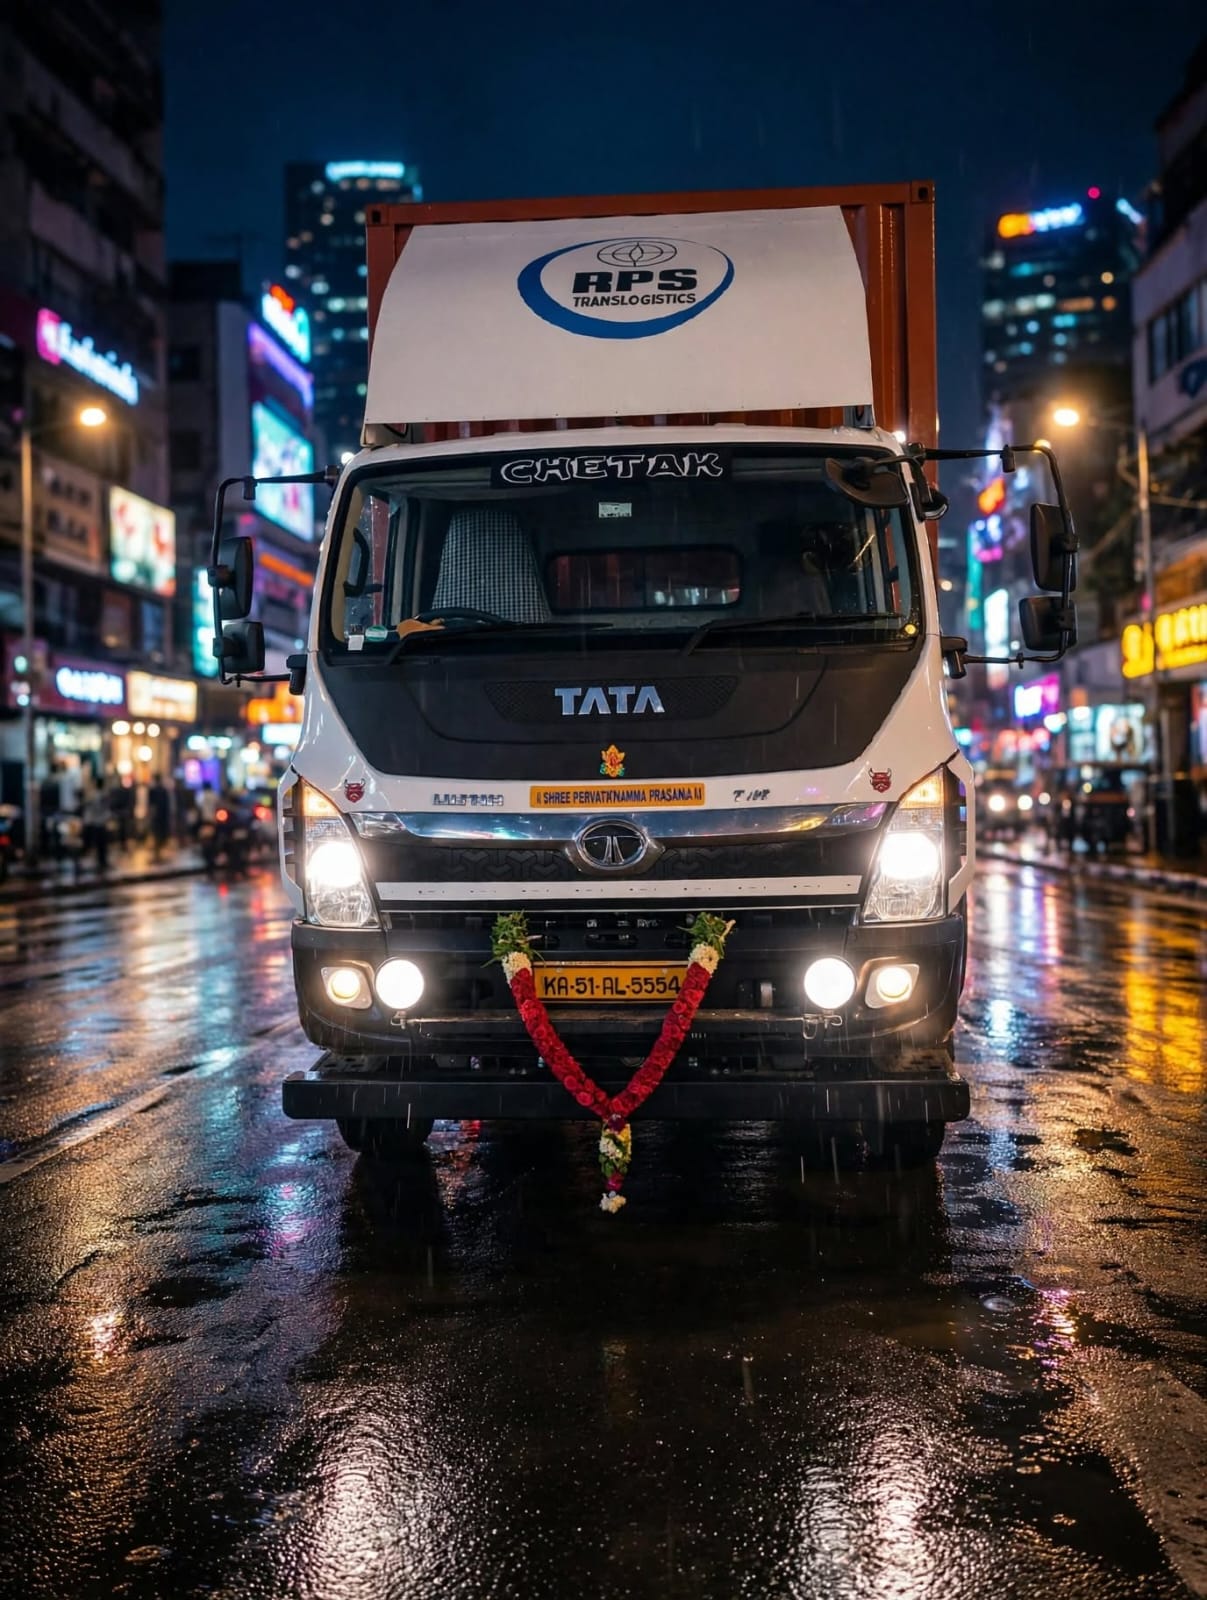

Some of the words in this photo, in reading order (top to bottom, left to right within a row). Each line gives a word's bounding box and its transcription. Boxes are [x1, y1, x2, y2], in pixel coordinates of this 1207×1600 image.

[572, 268, 697, 293] RPS
[572, 293, 696, 308] TRANSLOGISTICS
[501, 453, 723, 483] CHETAK
[554, 686, 665, 716] TATA
[543, 791, 571, 804] SHREE
